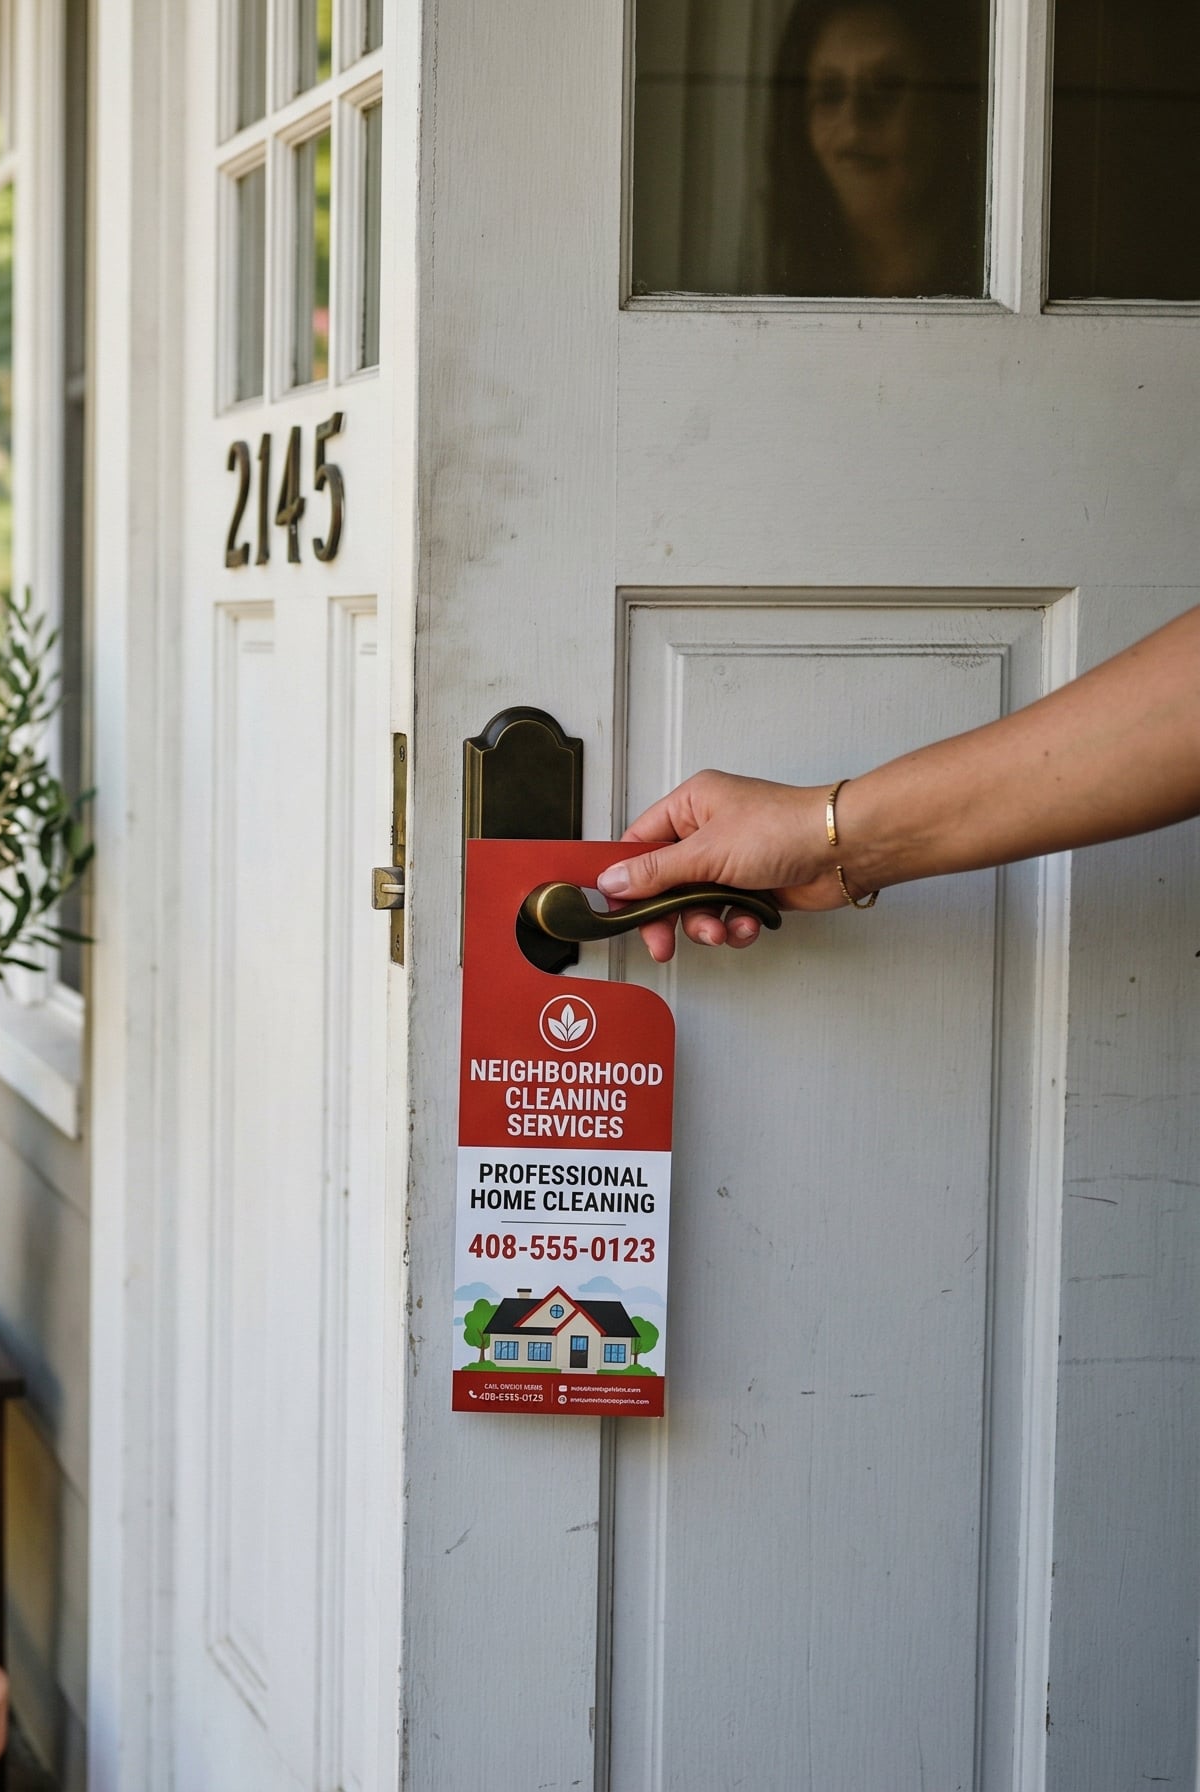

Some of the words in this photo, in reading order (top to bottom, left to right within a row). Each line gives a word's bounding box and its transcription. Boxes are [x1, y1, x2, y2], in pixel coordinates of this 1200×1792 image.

[225, 412, 345, 568] 2145
[470, 1059, 663, 1086] NEIGHBORHOOD
[505, 1086, 627, 1111] CLEANING
[507, 1114, 624, 1138] SERVICES
[479, 1163, 648, 1187] PROFESSIONAL
[470, 1189, 536, 1210] HOME
[543, 1191, 655, 1214] CLEANING
[468, 1233, 656, 1263] 408-555-0123
